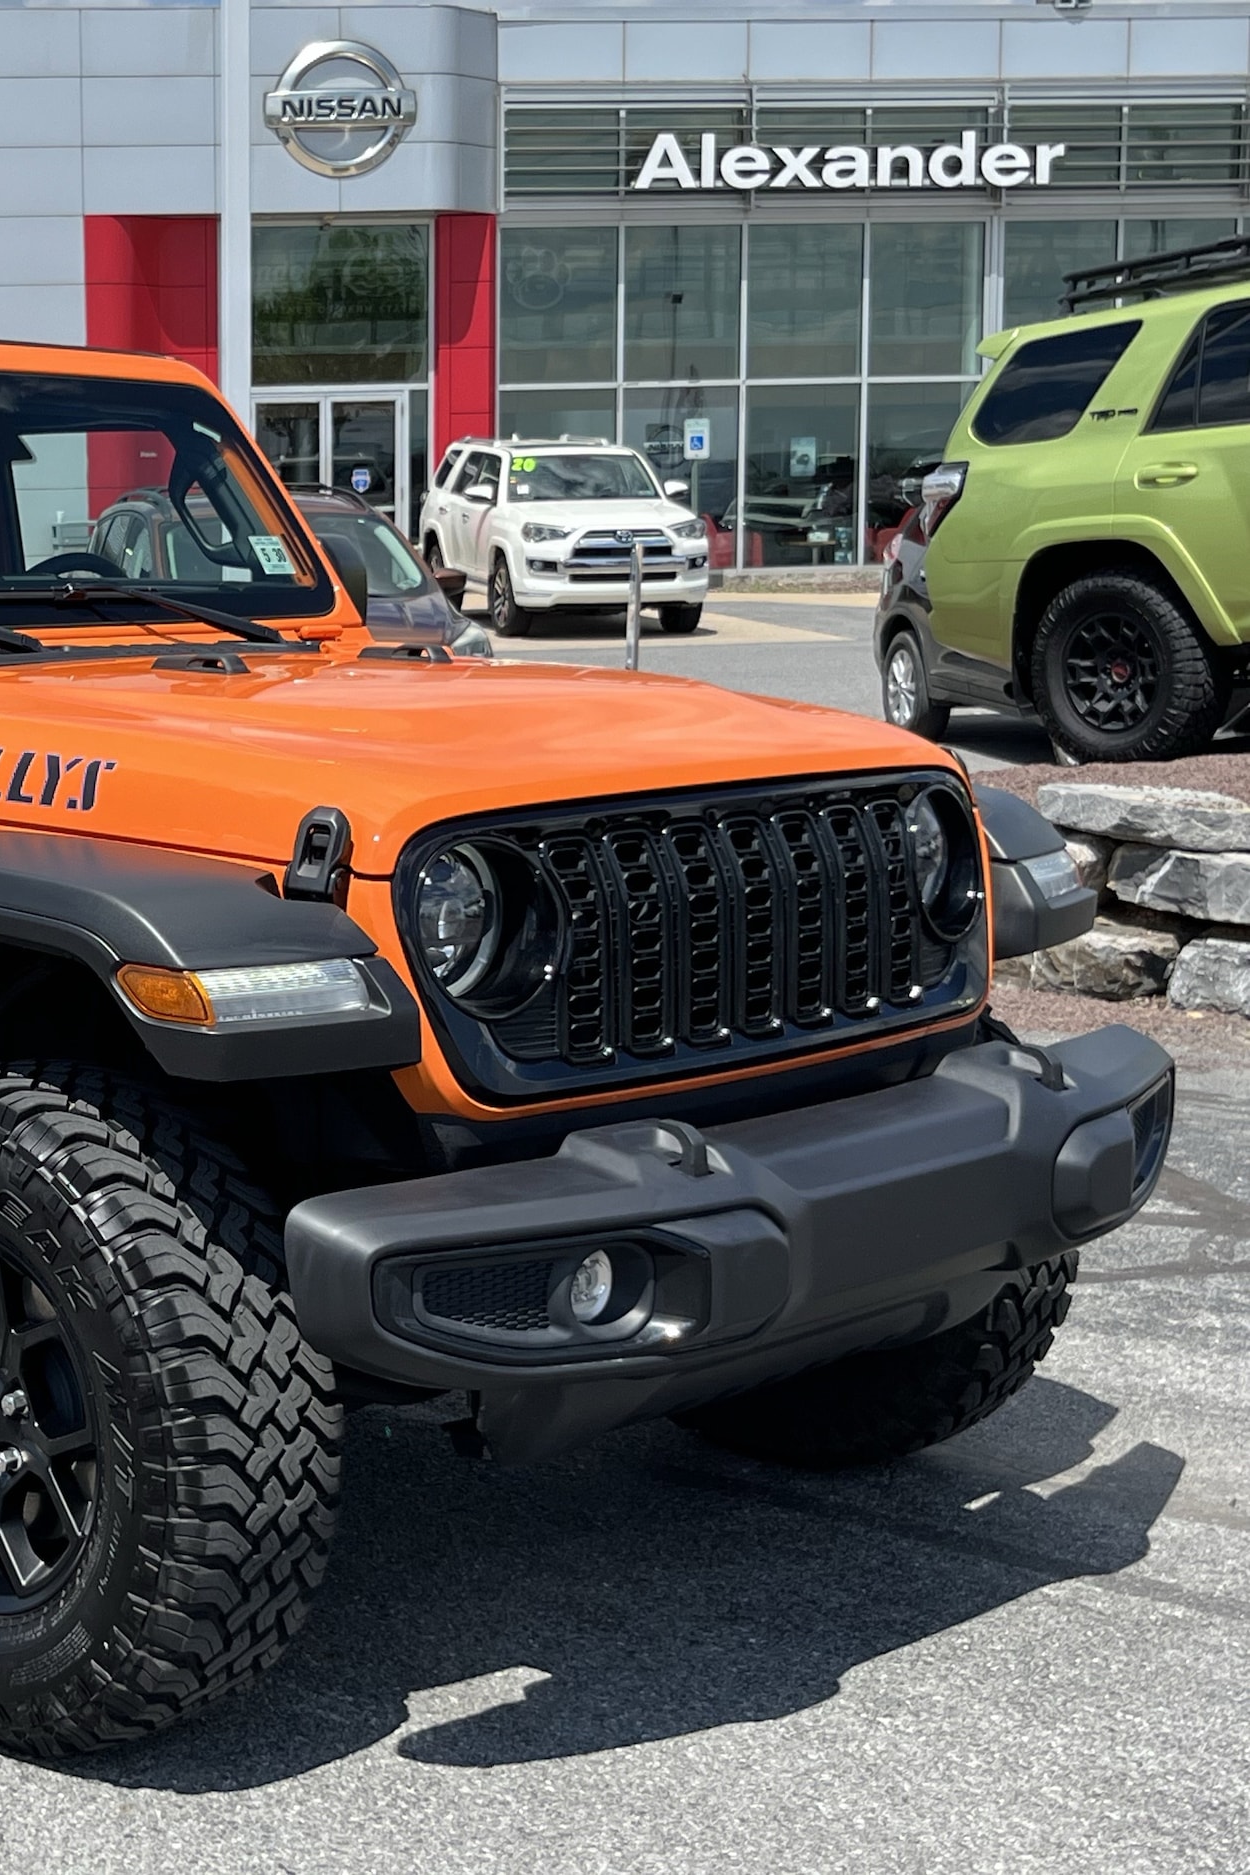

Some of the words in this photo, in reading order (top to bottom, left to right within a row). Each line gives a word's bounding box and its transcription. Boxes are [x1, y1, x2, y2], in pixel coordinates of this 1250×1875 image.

[281, 97, 404, 121] NISSAN
[635, 131, 1066, 188] Alexander
[511, 457, 536, 472] 20
[260, 548, 271, 562] 5
